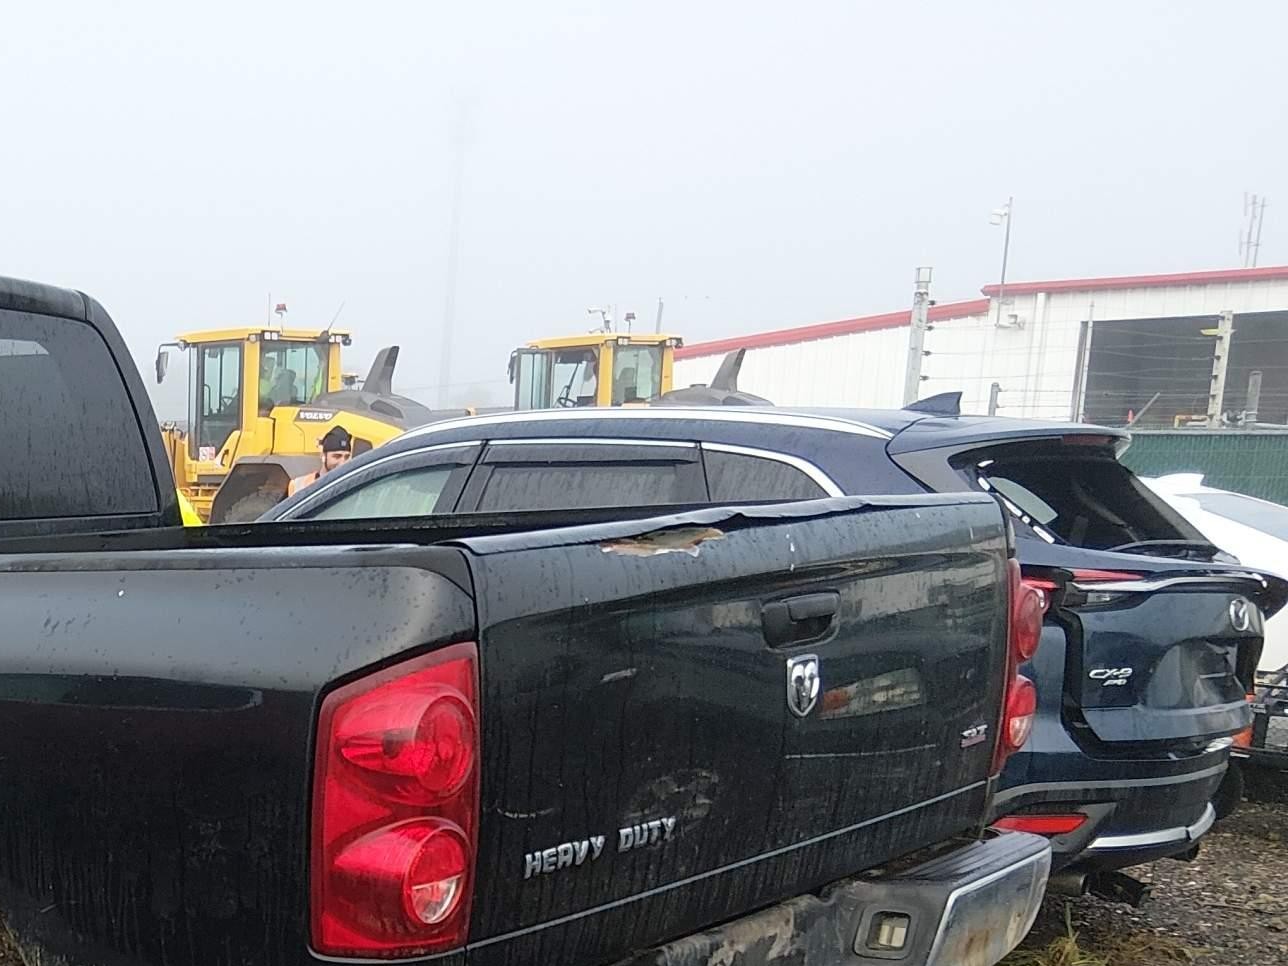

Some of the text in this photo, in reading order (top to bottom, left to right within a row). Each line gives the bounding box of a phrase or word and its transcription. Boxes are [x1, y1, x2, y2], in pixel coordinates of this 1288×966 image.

[1089, 667, 1133, 679] CX-9
[524, 816, 676, 879] HEAVY DUTY
